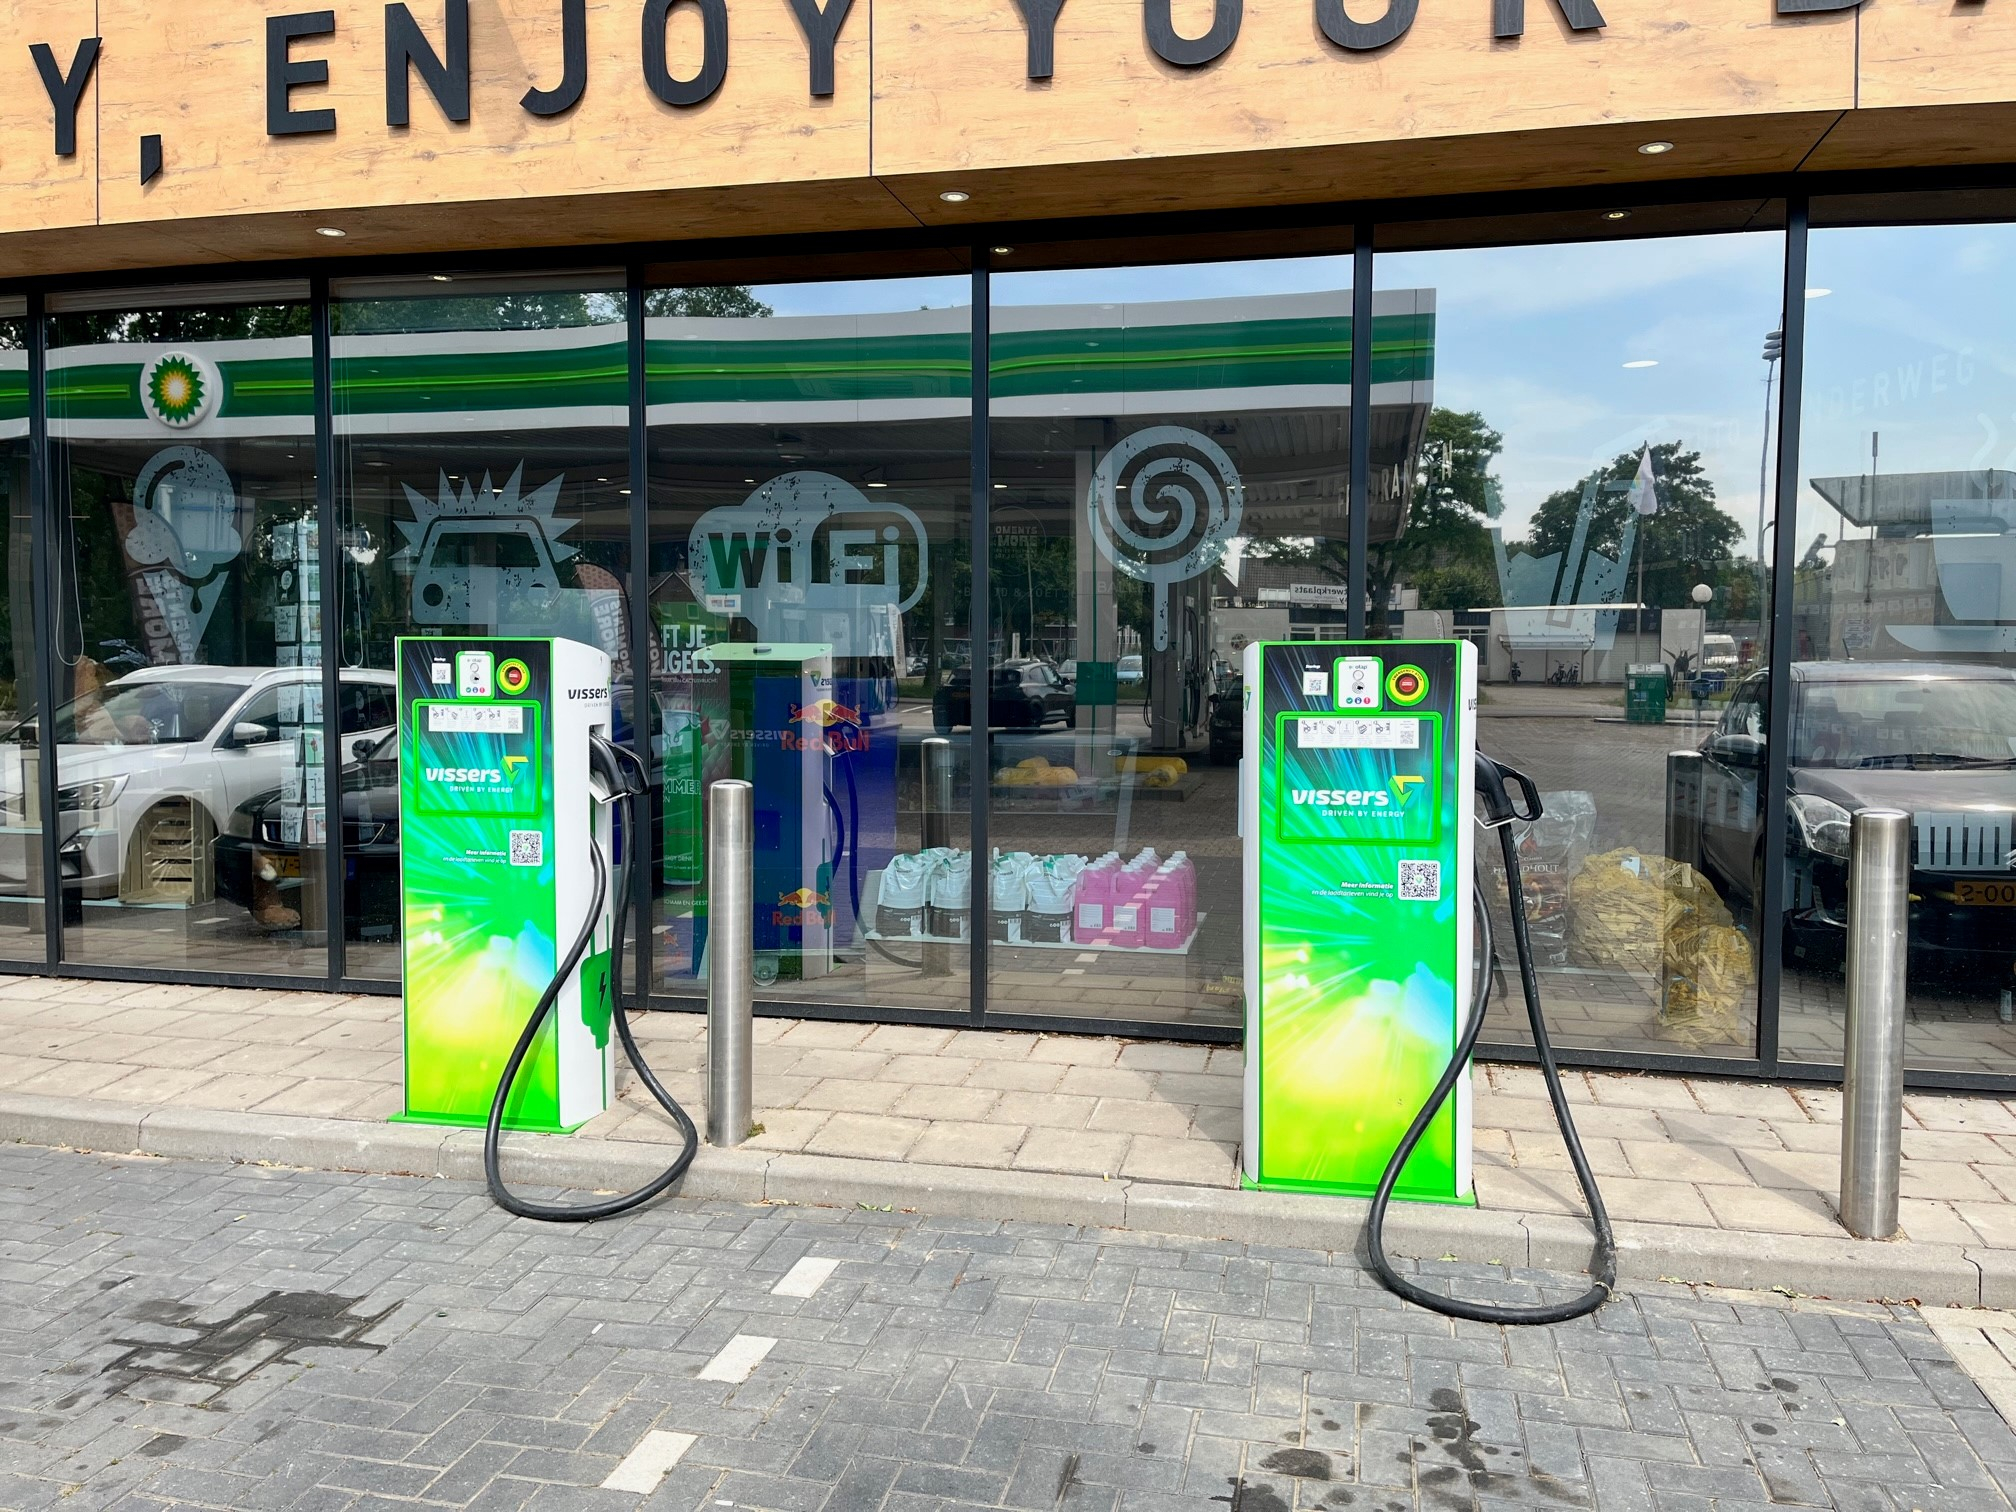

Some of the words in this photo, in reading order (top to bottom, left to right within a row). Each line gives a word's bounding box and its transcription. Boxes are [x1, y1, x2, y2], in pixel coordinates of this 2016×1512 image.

[266, 0, 856, 136] ENJOY
[661, 624, 680, 648] FT
[686, 624, 707, 648] JE
[1393, 669, 1414, 681] EMERGENCY
[781, 730, 823, 751] Red
[828, 730, 870, 752] Bull
[450, 785, 475, 793] DRIVEN
[487, 786, 514, 794] ENERGY
[1321, 809, 1354, 817] DRIVEN
[1371, 810, 1405, 818] ENERGY
[1359, 882, 1394, 890] informatie
[772, 911, 803, 926] Red
[806, 910, 837, 926] Bull
